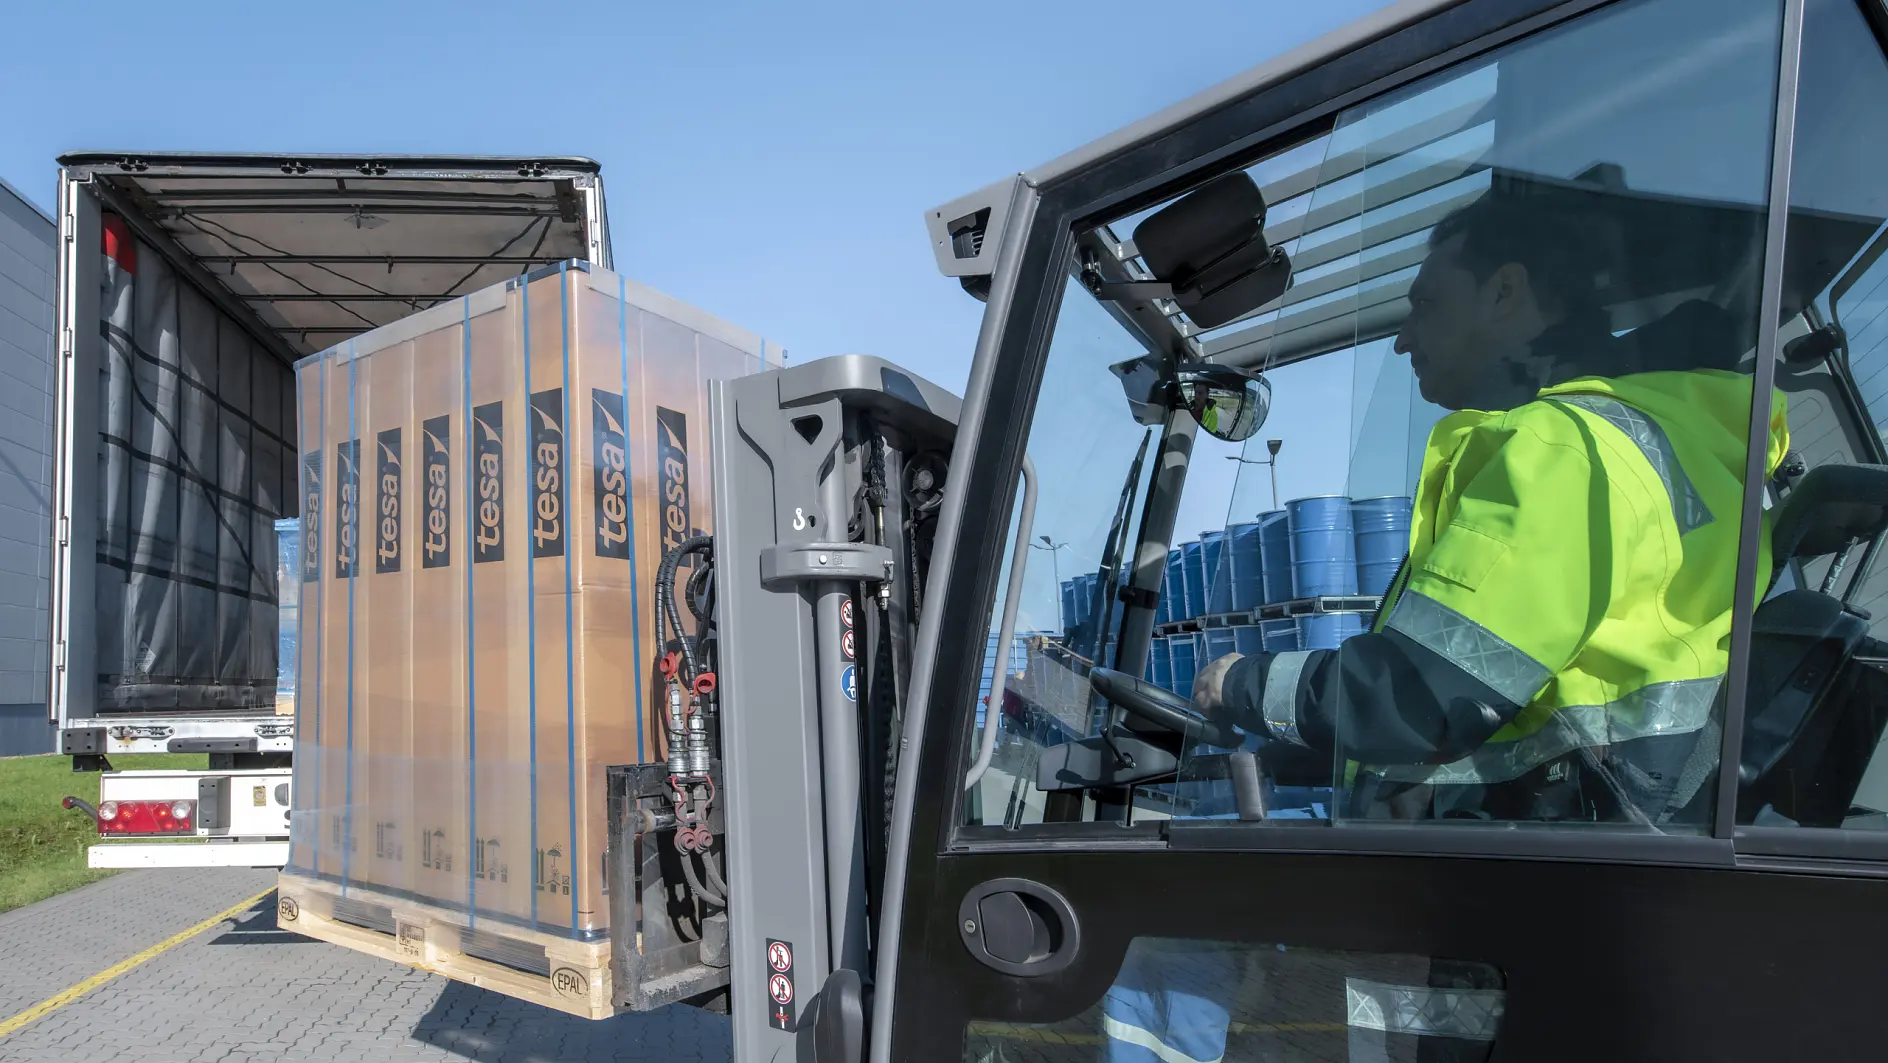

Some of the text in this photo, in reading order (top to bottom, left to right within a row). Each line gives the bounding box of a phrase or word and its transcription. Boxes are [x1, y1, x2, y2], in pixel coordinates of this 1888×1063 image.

[305, 493, 319, 574] tesa
[338, 483, 357, 571] tesa
[378, 473, 398, 566] tesa
[425, 463, 447, 561] tesa
[476, 452, 500, 555] tesa
[533, 442, 560, 549] tesa
[599, 442, 628, 549] tesa
[663, 456, 687, 553] tesa
[281, 900, 296, 918] EPAL
[557, 972, 583, 996] EPAL
